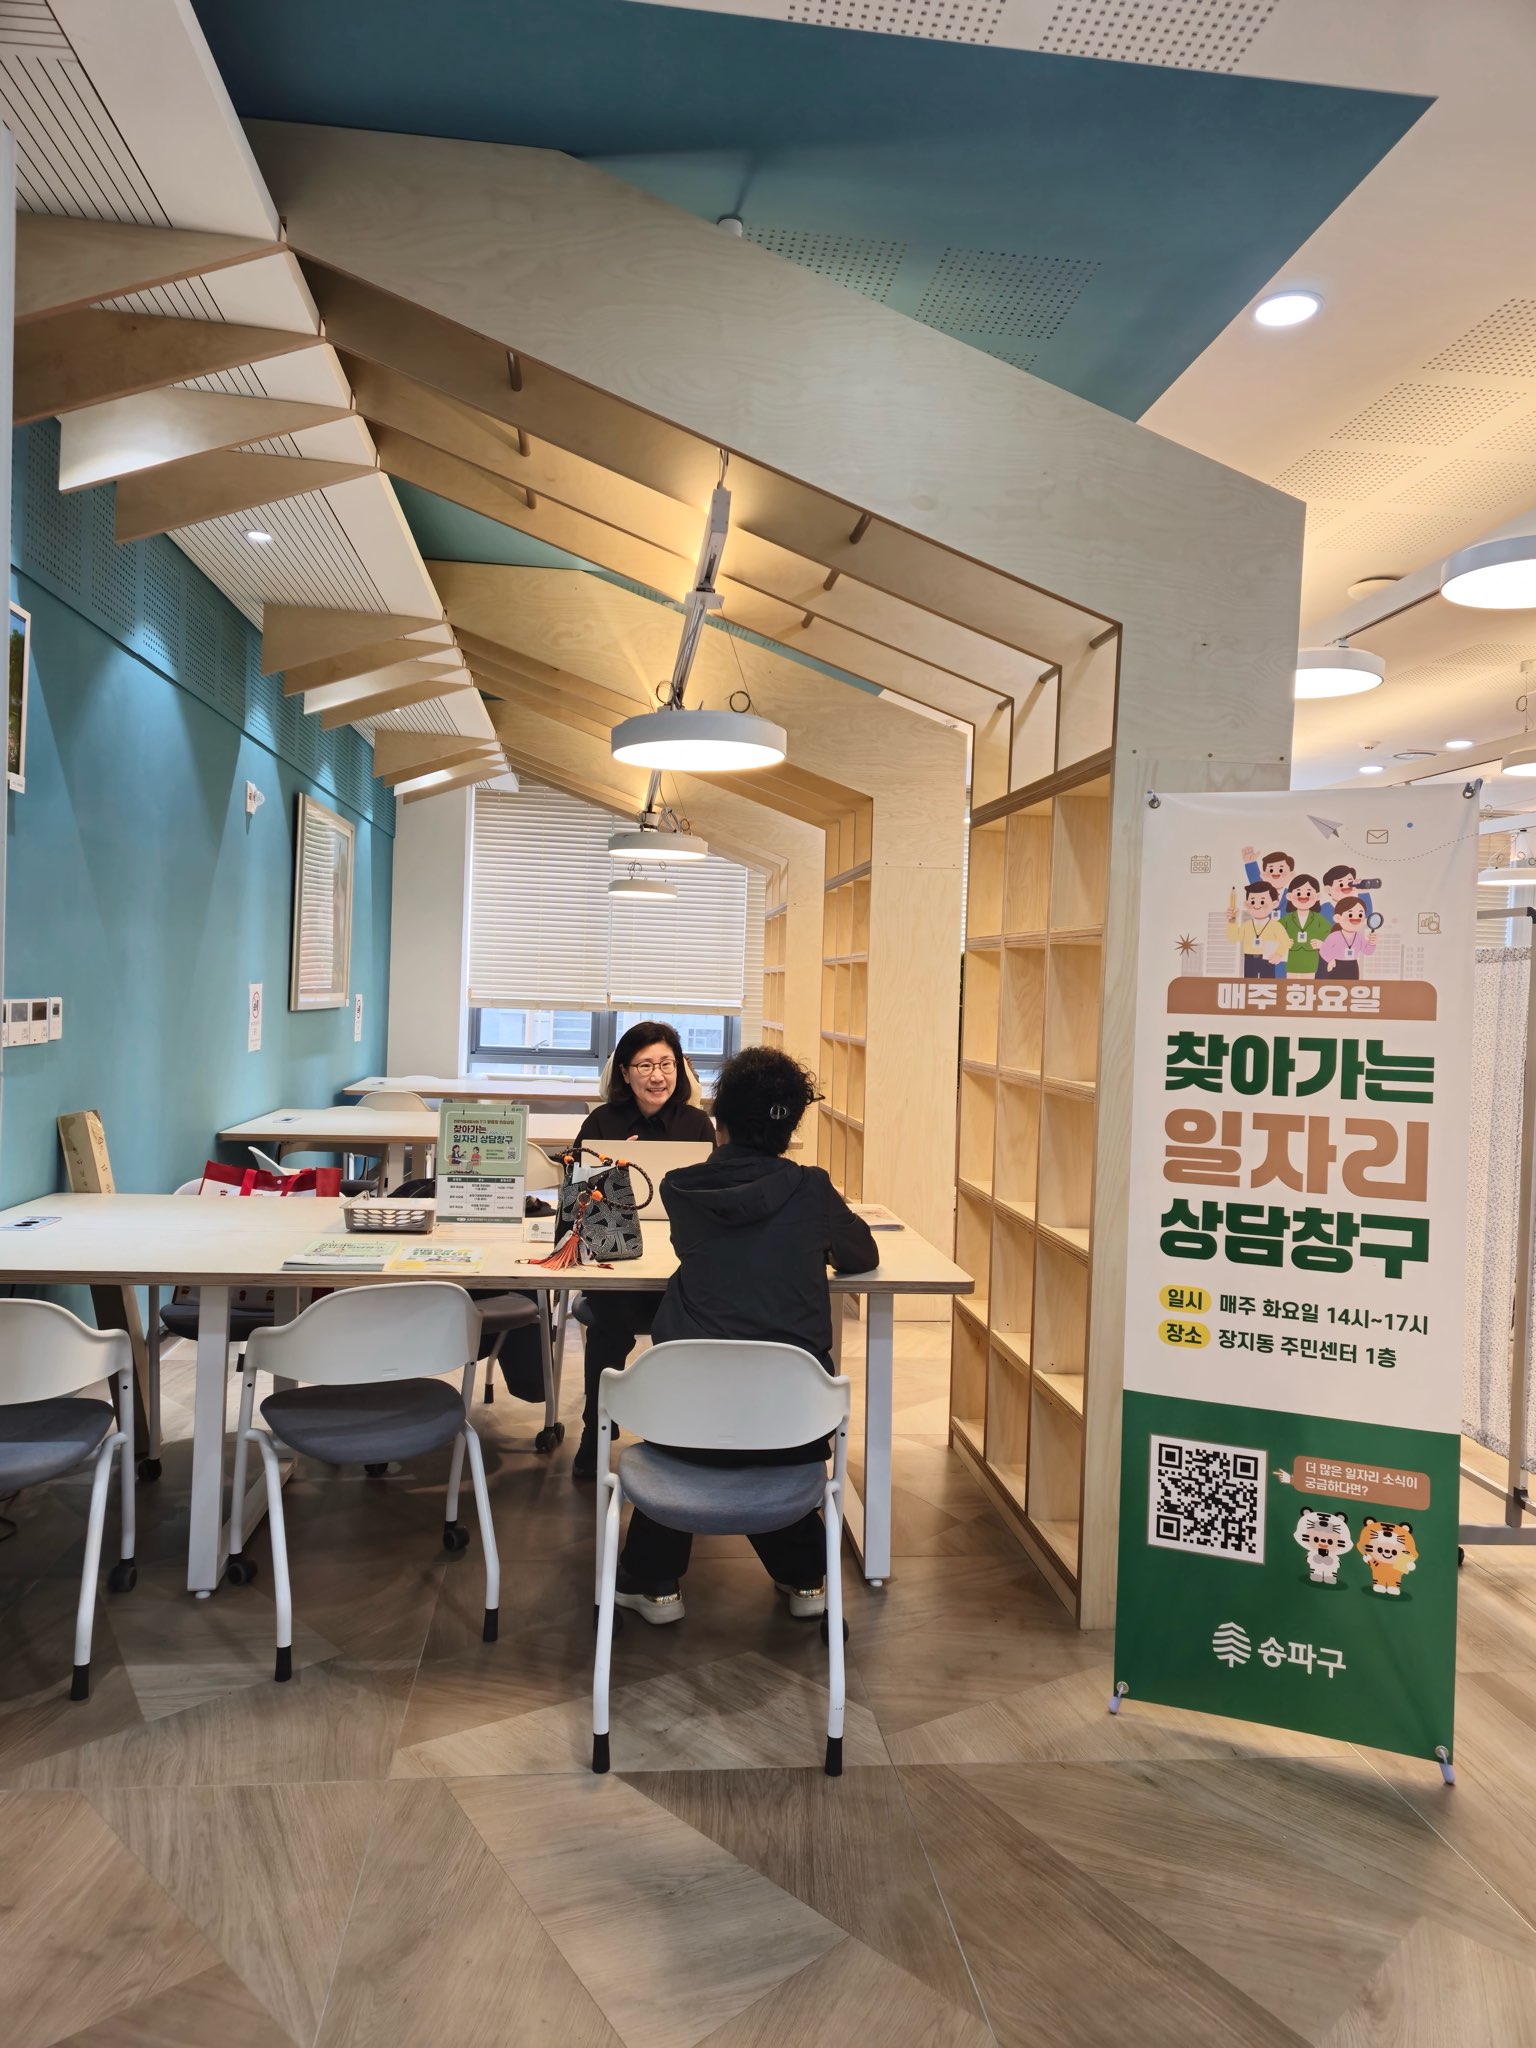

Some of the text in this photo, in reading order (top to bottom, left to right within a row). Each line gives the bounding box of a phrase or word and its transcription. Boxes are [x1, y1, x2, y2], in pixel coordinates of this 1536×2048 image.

[1217, 982, 1381, 1013] 매주 화요일
[1165, 1031, 1435, 1104] 찾아가는
[453, 1125, 486, 1134] 찾아가는
[453, 1134, 513, 1144] 일자리 상담창구
[1162, 1108, 1430, 1203] 일자리
[1159, 1197, 1430, 1280] 상담창구
[1167, 1288, 1429, 1336] 일시 매주 화요일 14시~17시
[1166, 1322, 1397, 1369] 장소 장지동 주민센터 1층
[1304, 1476, 1369, 1496] 궁금하다면?
[1305, 1461, 1418, 1489] 더 많은 일자리 소식이
[1257, 1636, 1347, 1679] 송파구
